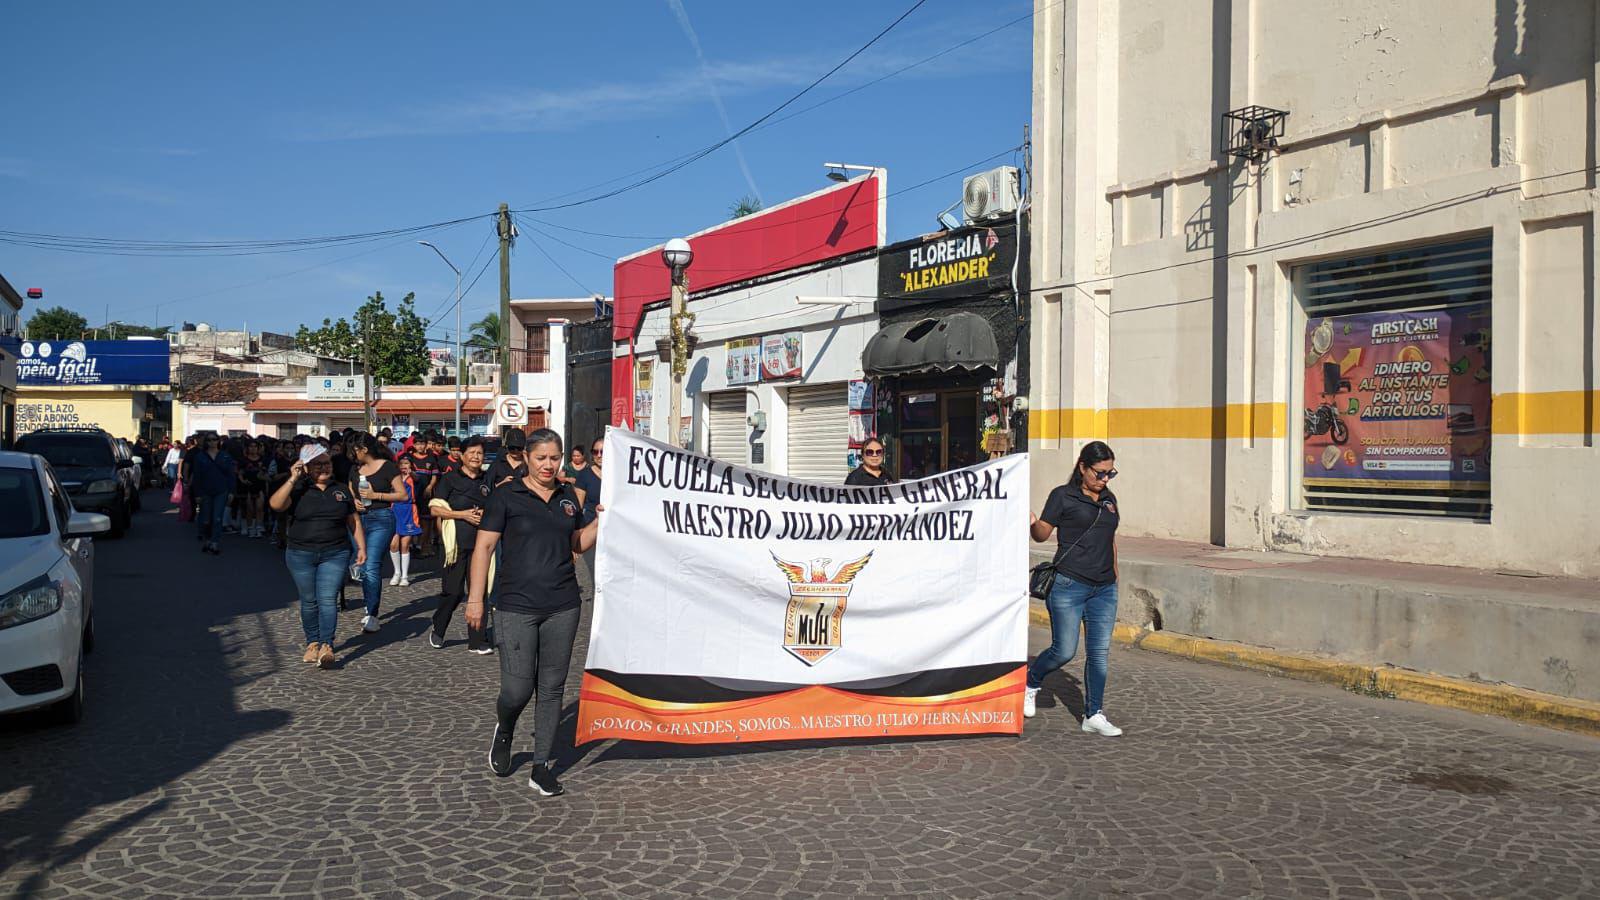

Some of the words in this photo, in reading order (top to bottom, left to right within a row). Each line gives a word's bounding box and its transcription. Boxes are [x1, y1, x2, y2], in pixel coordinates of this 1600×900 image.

[909, 234, 983, 269] FLORERIA
[1374, 361, 1432, 376] ¡DINERO
[1359, 379, 1376, 391] AL
[1380, 374, 1449, 389] INSTANTE
[1373, 391, 1402, 403] POR
[1406, 390, 1433, 402] TUS
[44, 404, 75, 413] PLAZO
[43, 413, 79, 422] ABONOS
[1365, 447, 1381, 455] SIN
[1383, 446, 1448, 455] COMPROMISO.
[627, 446, 735, 496] ESCUELA
[900, 468, 1008, 504] GENERAL
[662, 500, 772, 540] MAESTRO
[776, 511, 843, 541] JULIO
[846, 507, 975, 541] HERNÁNDEZ
[875, 713, 919, 728] JULIO
[922, 709, 1014, 728] HERNÁNDEZ!
